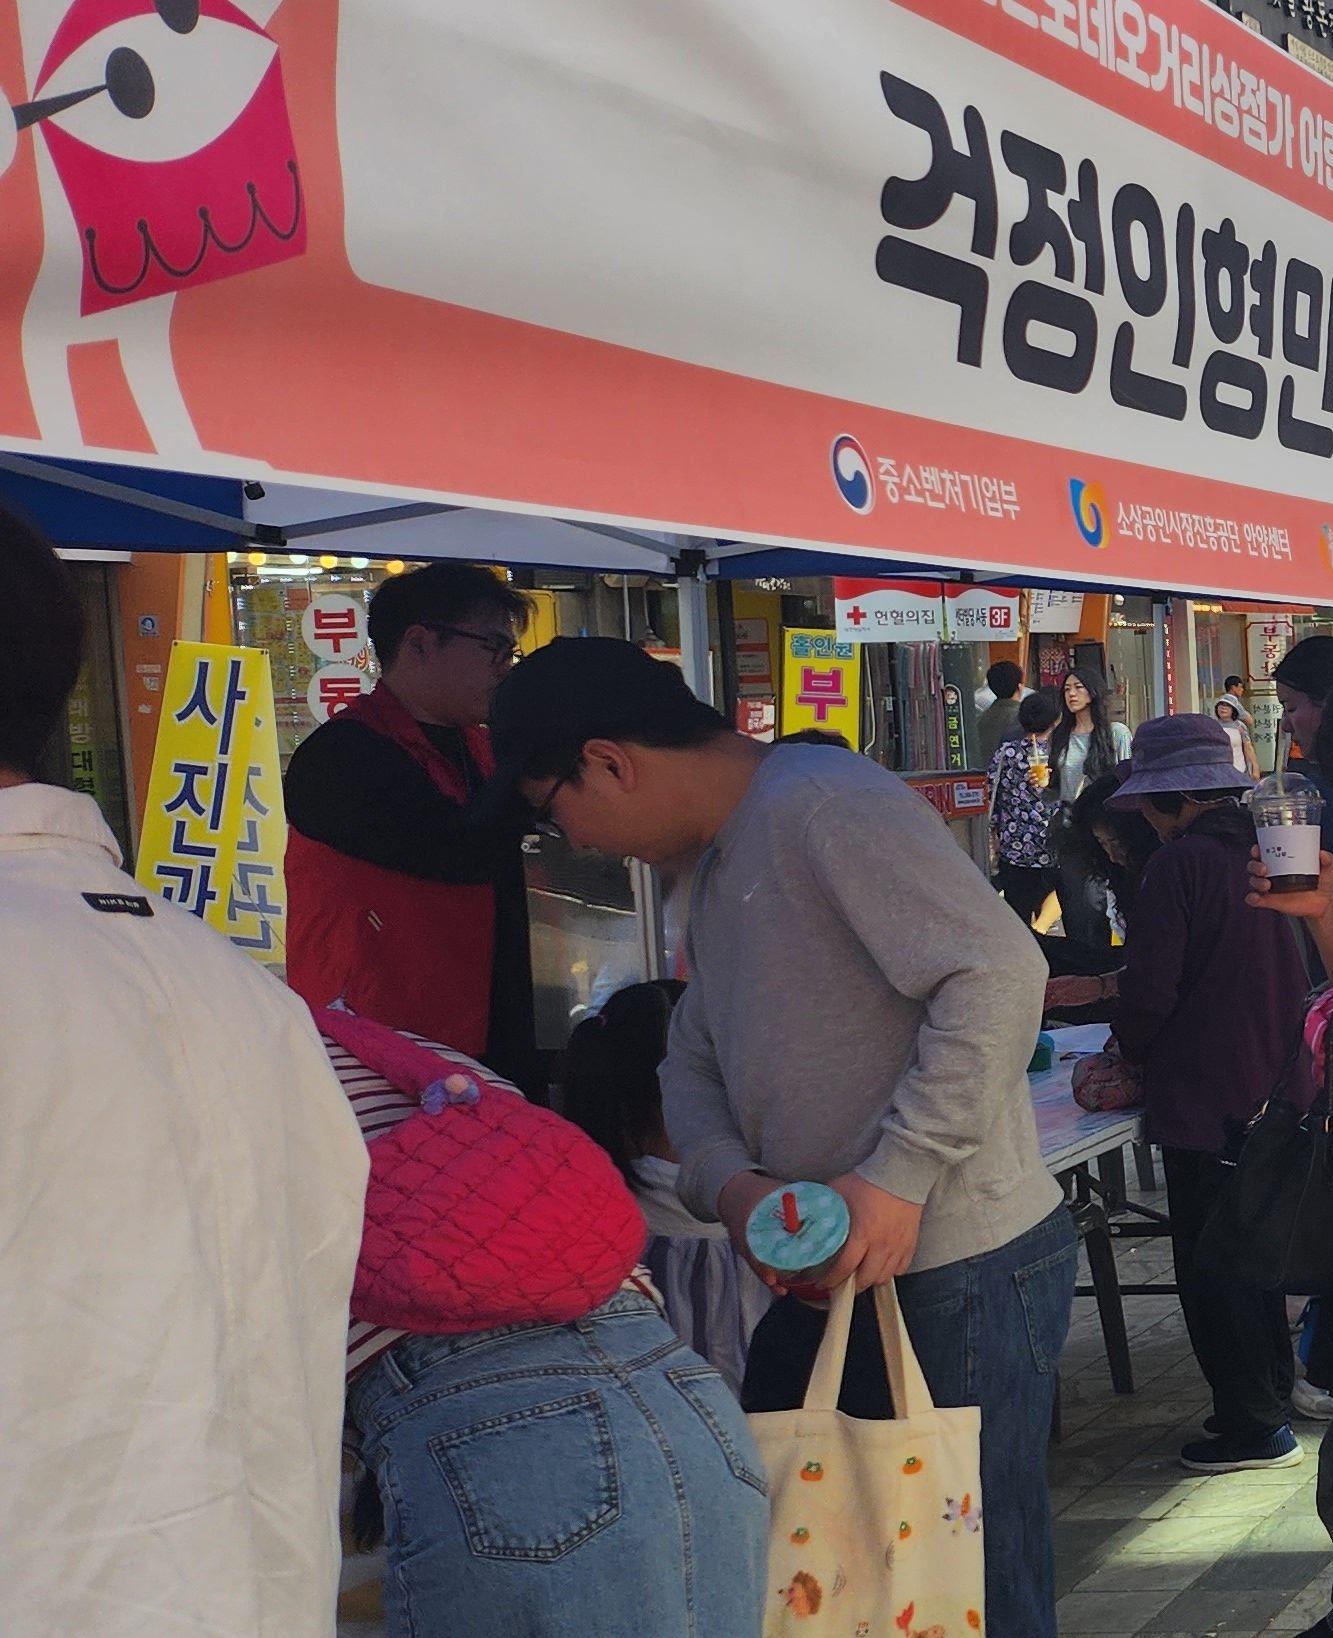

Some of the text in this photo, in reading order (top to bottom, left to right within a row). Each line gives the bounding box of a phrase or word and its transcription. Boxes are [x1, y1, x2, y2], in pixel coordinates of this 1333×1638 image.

[876, 455, 1022, 522] 중소벤처기업부
[1116, 501, 1293, 562] 소상공인시장진흥공단 안양센터
[873, 609, 936, 626] 헌혈의집
[992, 607, 1008, 625] 3F
